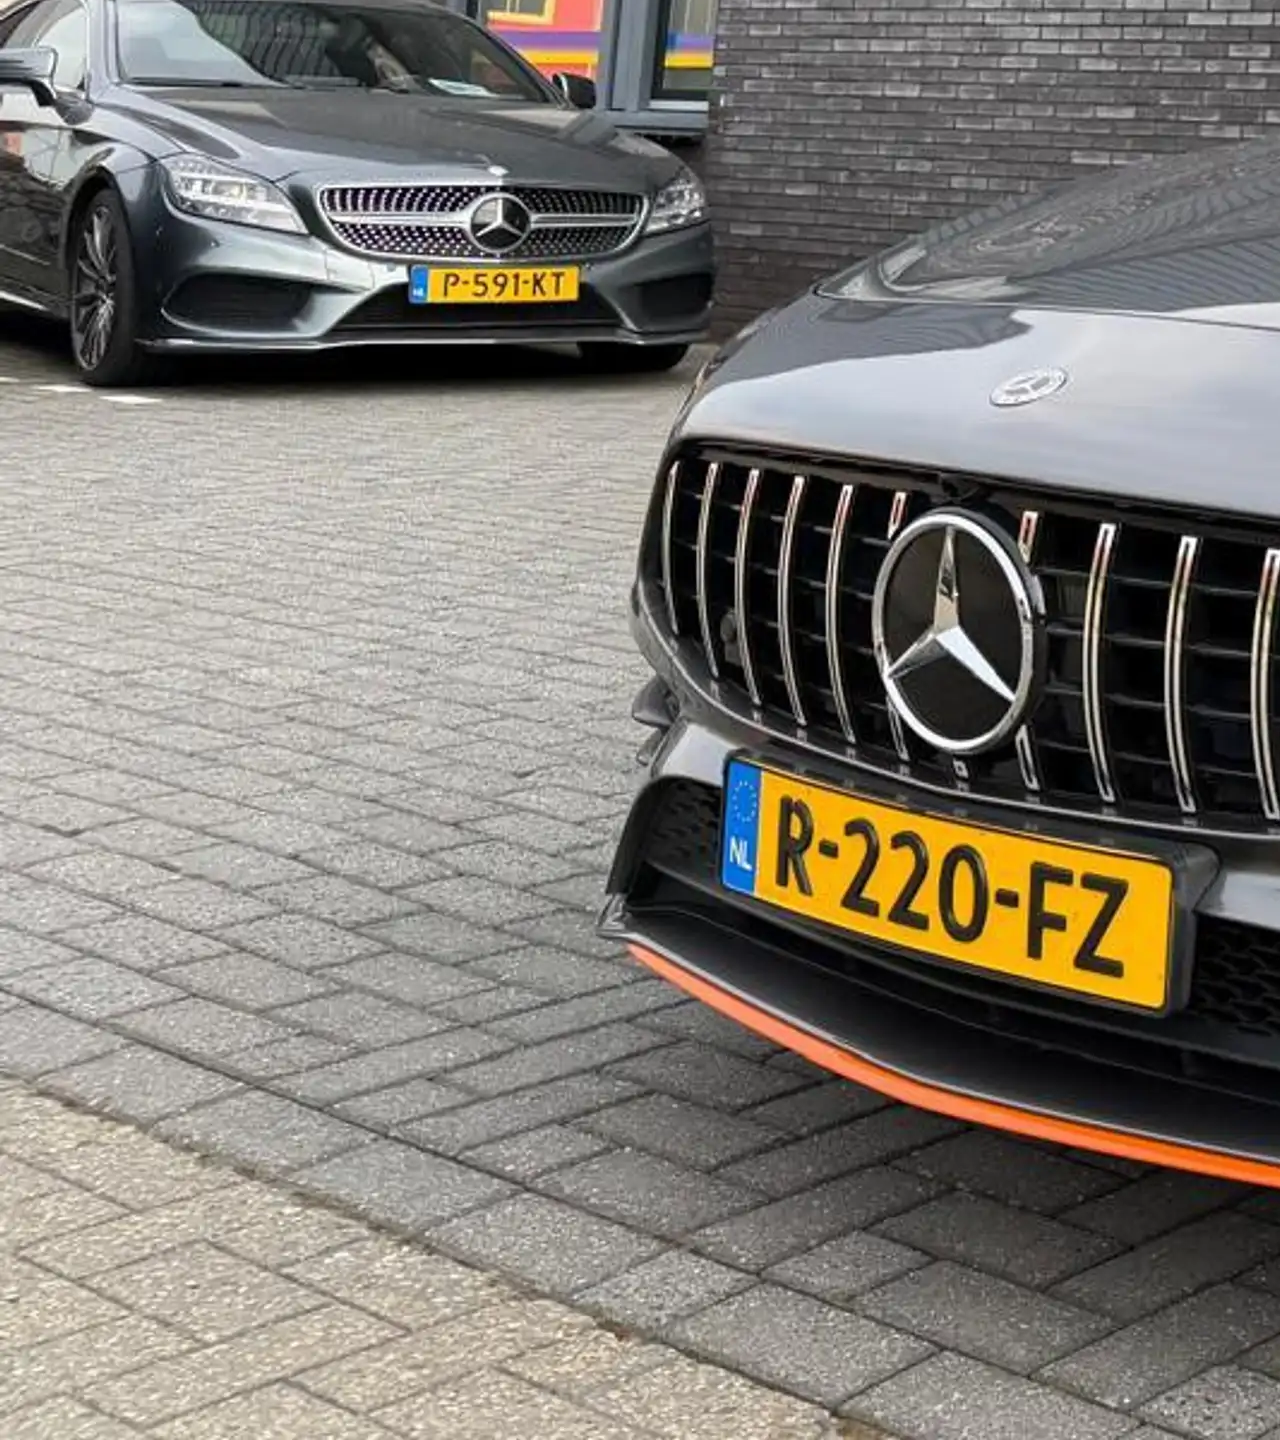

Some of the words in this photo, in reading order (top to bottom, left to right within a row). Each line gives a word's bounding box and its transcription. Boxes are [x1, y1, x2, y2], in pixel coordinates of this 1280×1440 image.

[442, 270, 567, 298] P-591-KT
[728, 835, 754, 873] NL
[773, 793, 1131, 980] R-220-FZ
